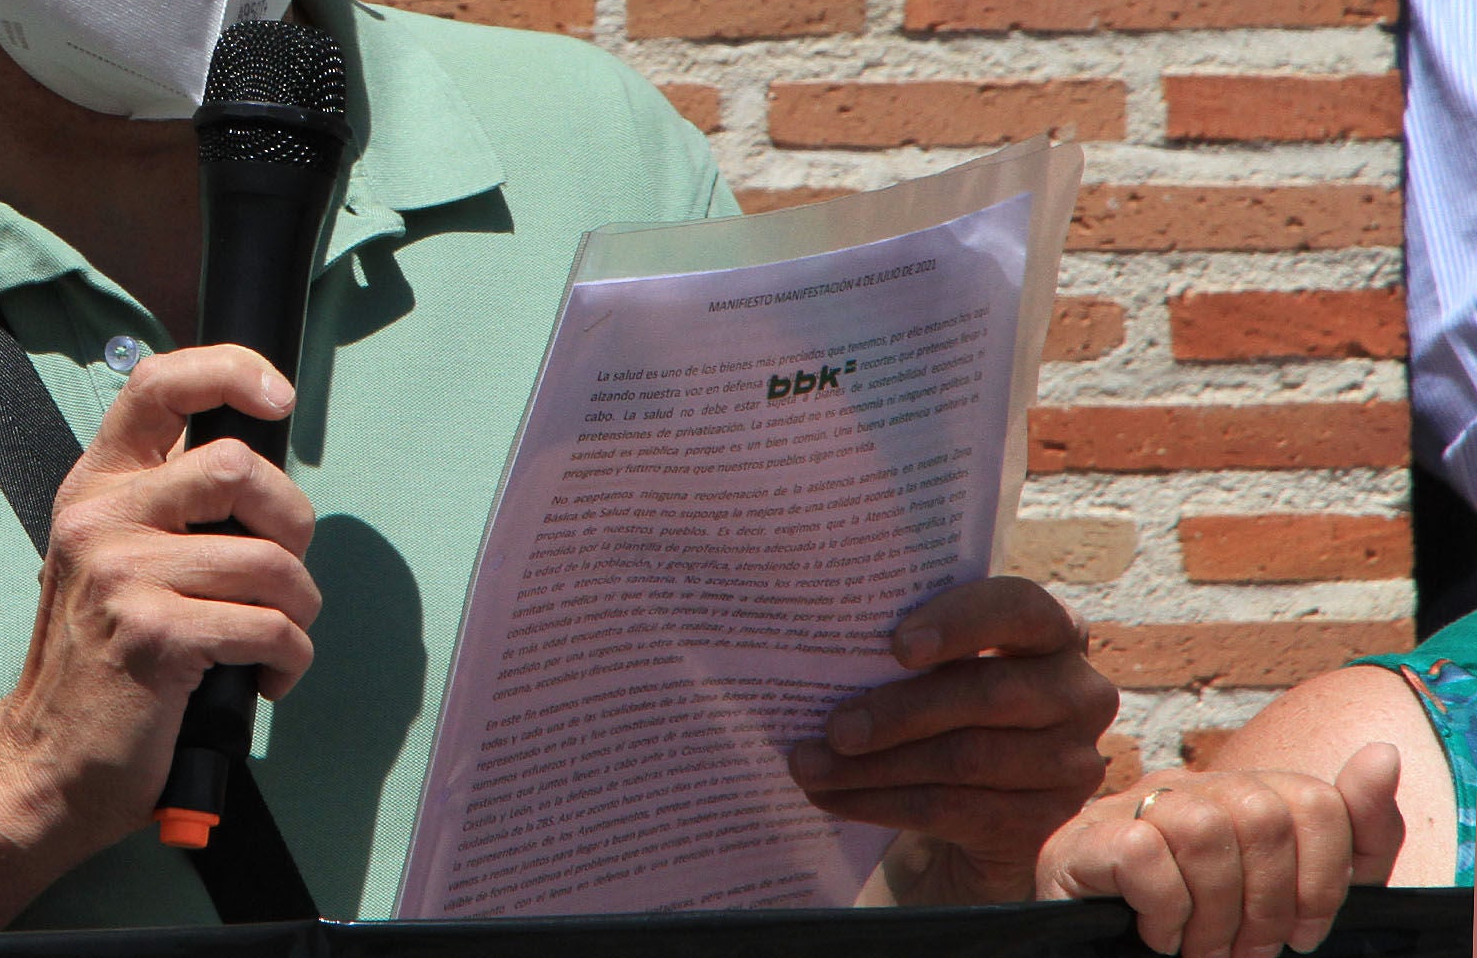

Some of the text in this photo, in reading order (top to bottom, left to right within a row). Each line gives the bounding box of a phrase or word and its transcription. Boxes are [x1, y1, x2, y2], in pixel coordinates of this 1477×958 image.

[596, 371, 610, 381] La
[612, 369, 643, 380] salud
[766, 365, 840, 399] bbk
[643, 408, 673, 419] salud
